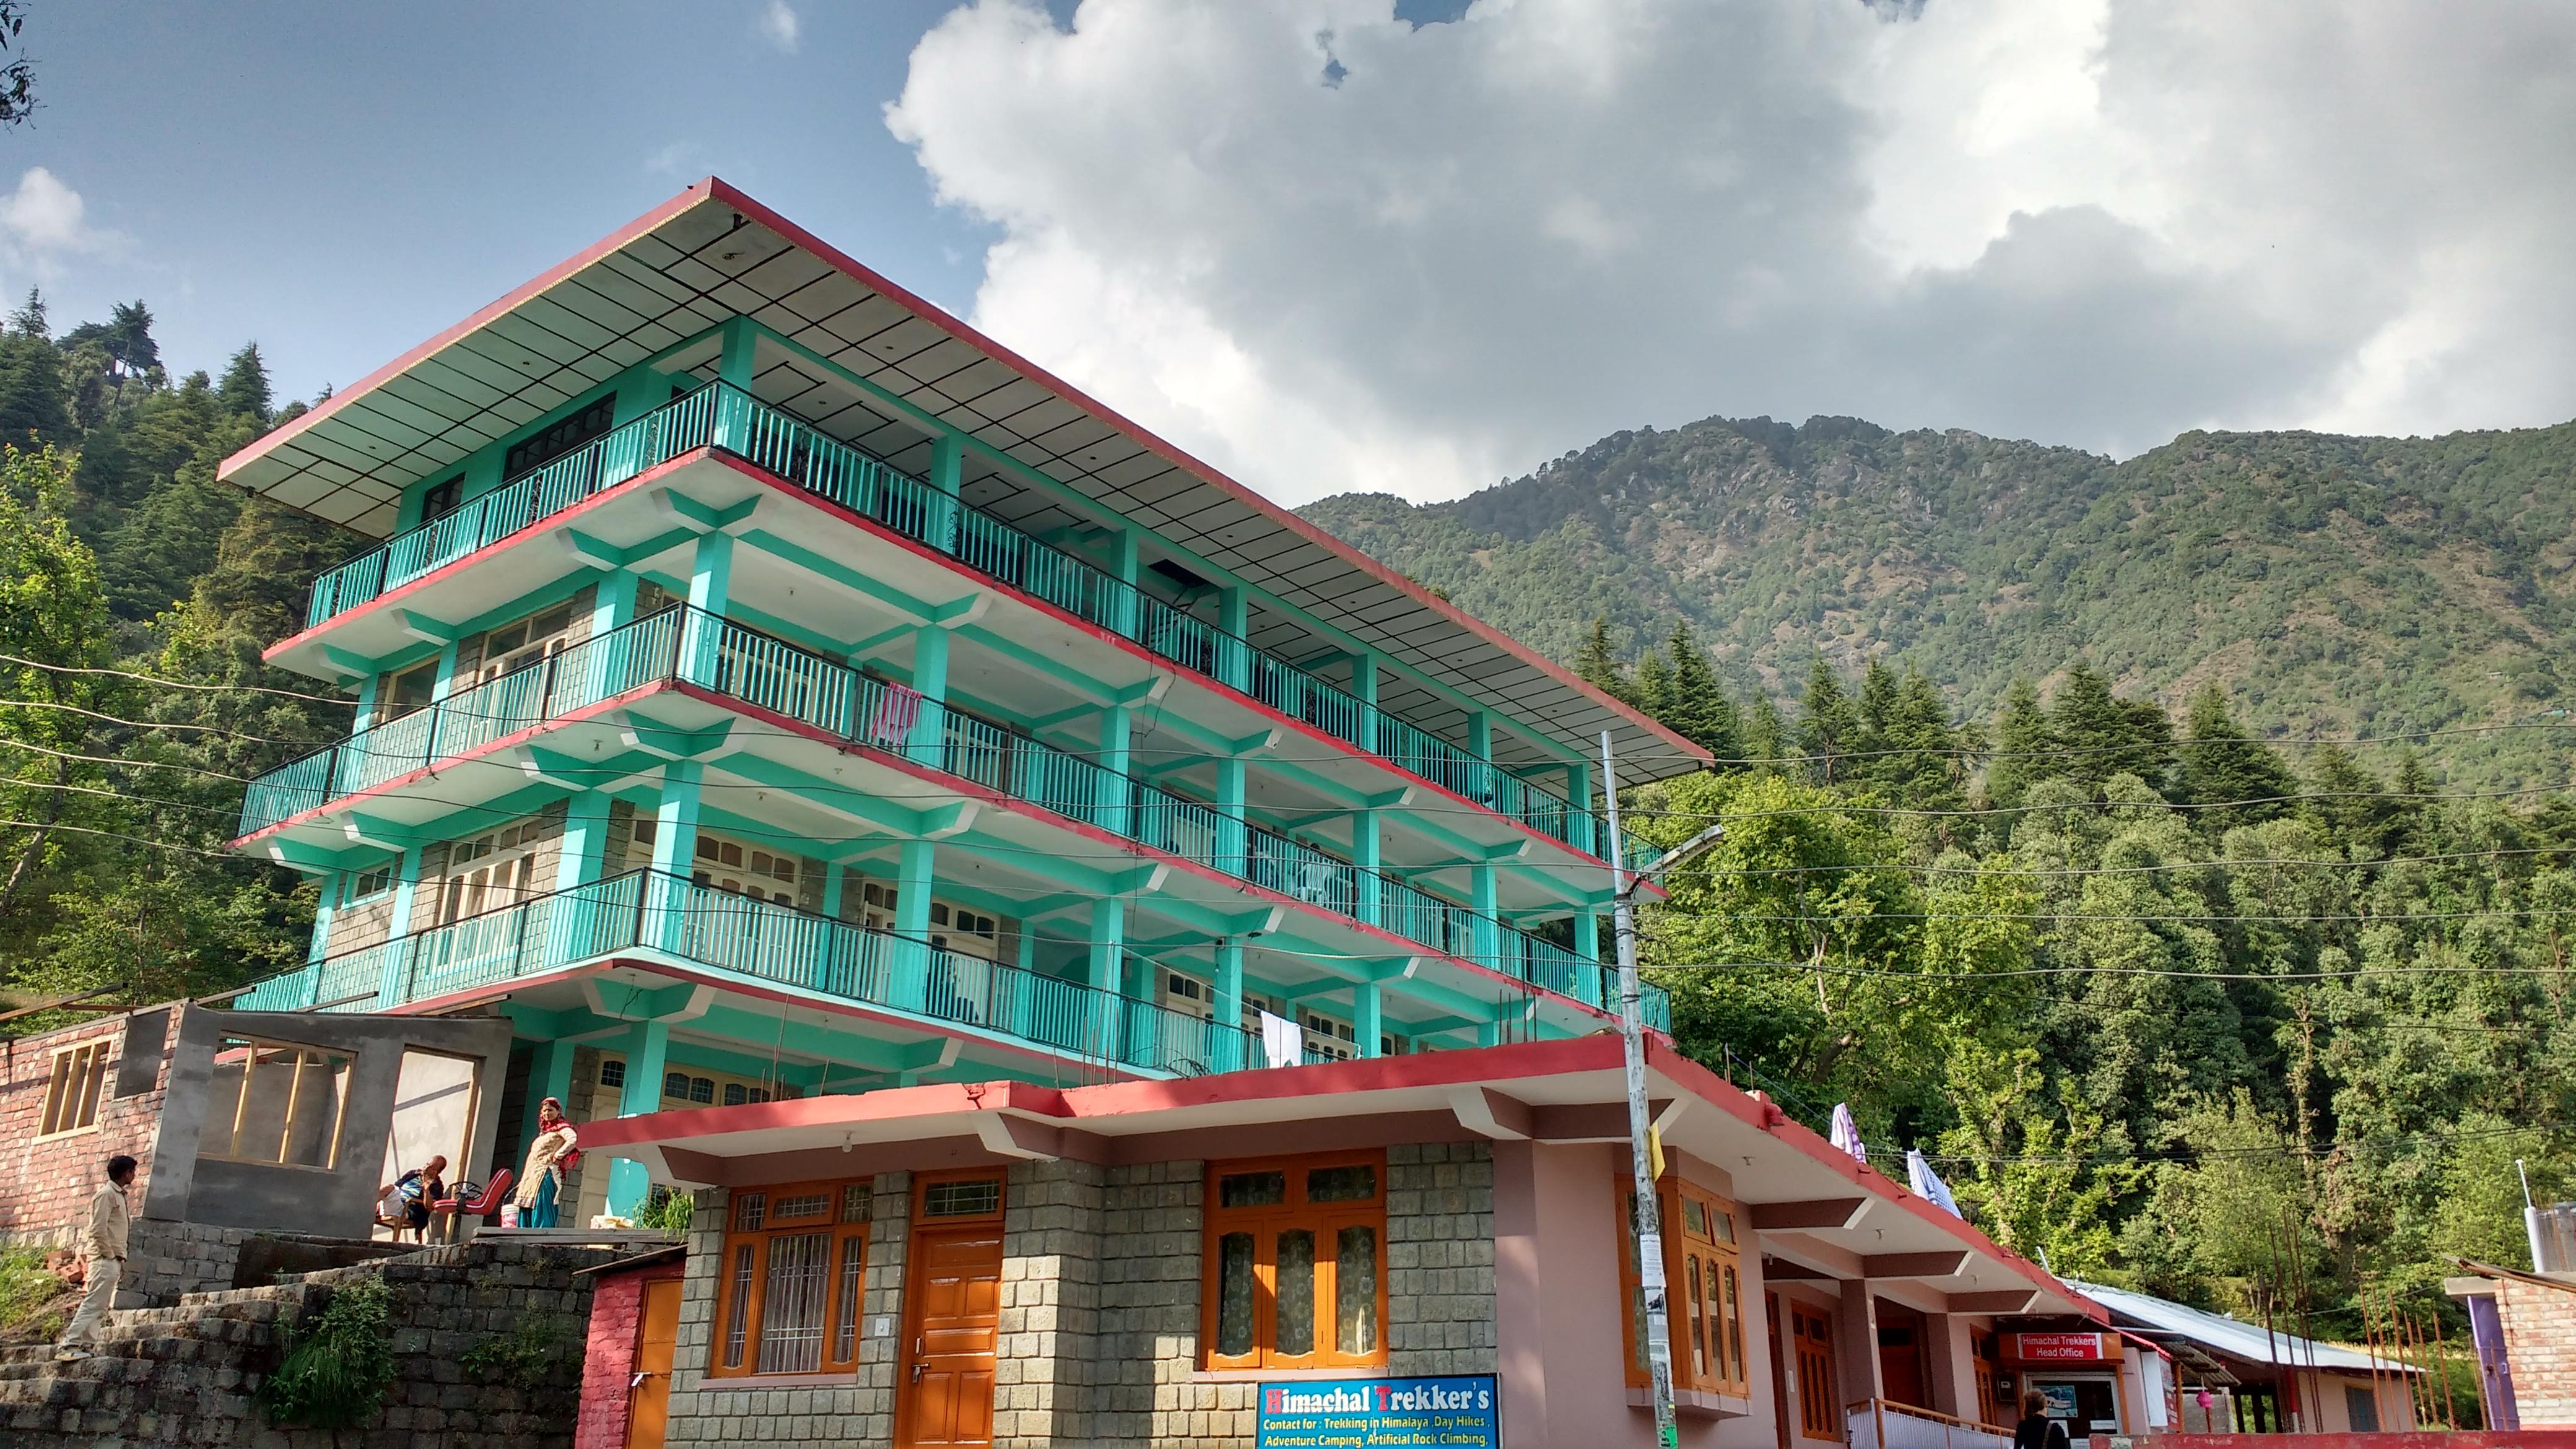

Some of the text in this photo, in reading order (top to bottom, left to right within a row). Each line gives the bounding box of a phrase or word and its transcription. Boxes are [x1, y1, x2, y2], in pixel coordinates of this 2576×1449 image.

[2023, 1336, 2096, 1346] Himachal Trekkers
[2037, 1347, 2084, 1357] Head Office
[1265, 1381, 1489, 1414] Himachal Trekker's
[1263, 1419, 1300, 1430] Contact
[1324, 1417, 1368, 1432] Trekking
[1370, 1416, 1380, 1428] in
[1264, 1432, 1489, 1448] Adventure Camping, Artificial Rock Climbing,
